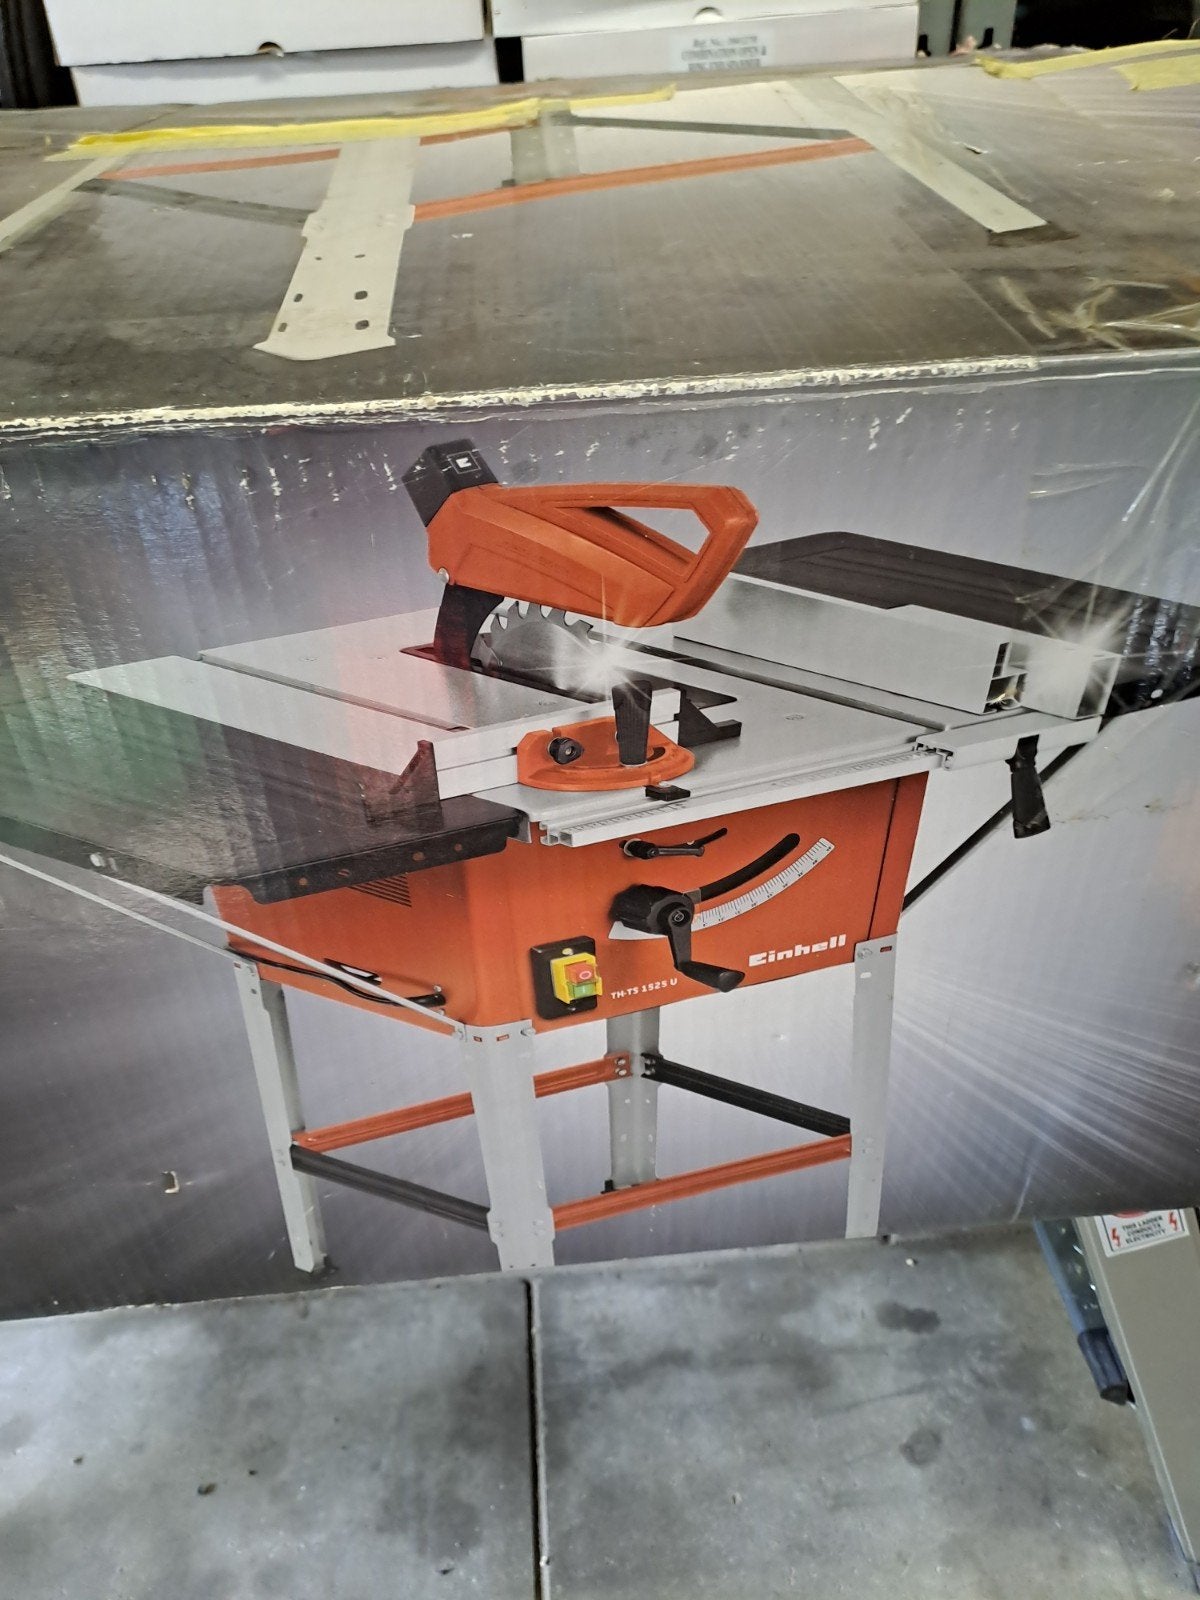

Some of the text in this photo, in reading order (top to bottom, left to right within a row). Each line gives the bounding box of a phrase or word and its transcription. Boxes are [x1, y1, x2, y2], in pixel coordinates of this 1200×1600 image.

[749, 934, 847, 967] Einhell
[610, 978, 678, 1000] TH-TS 1525 U
